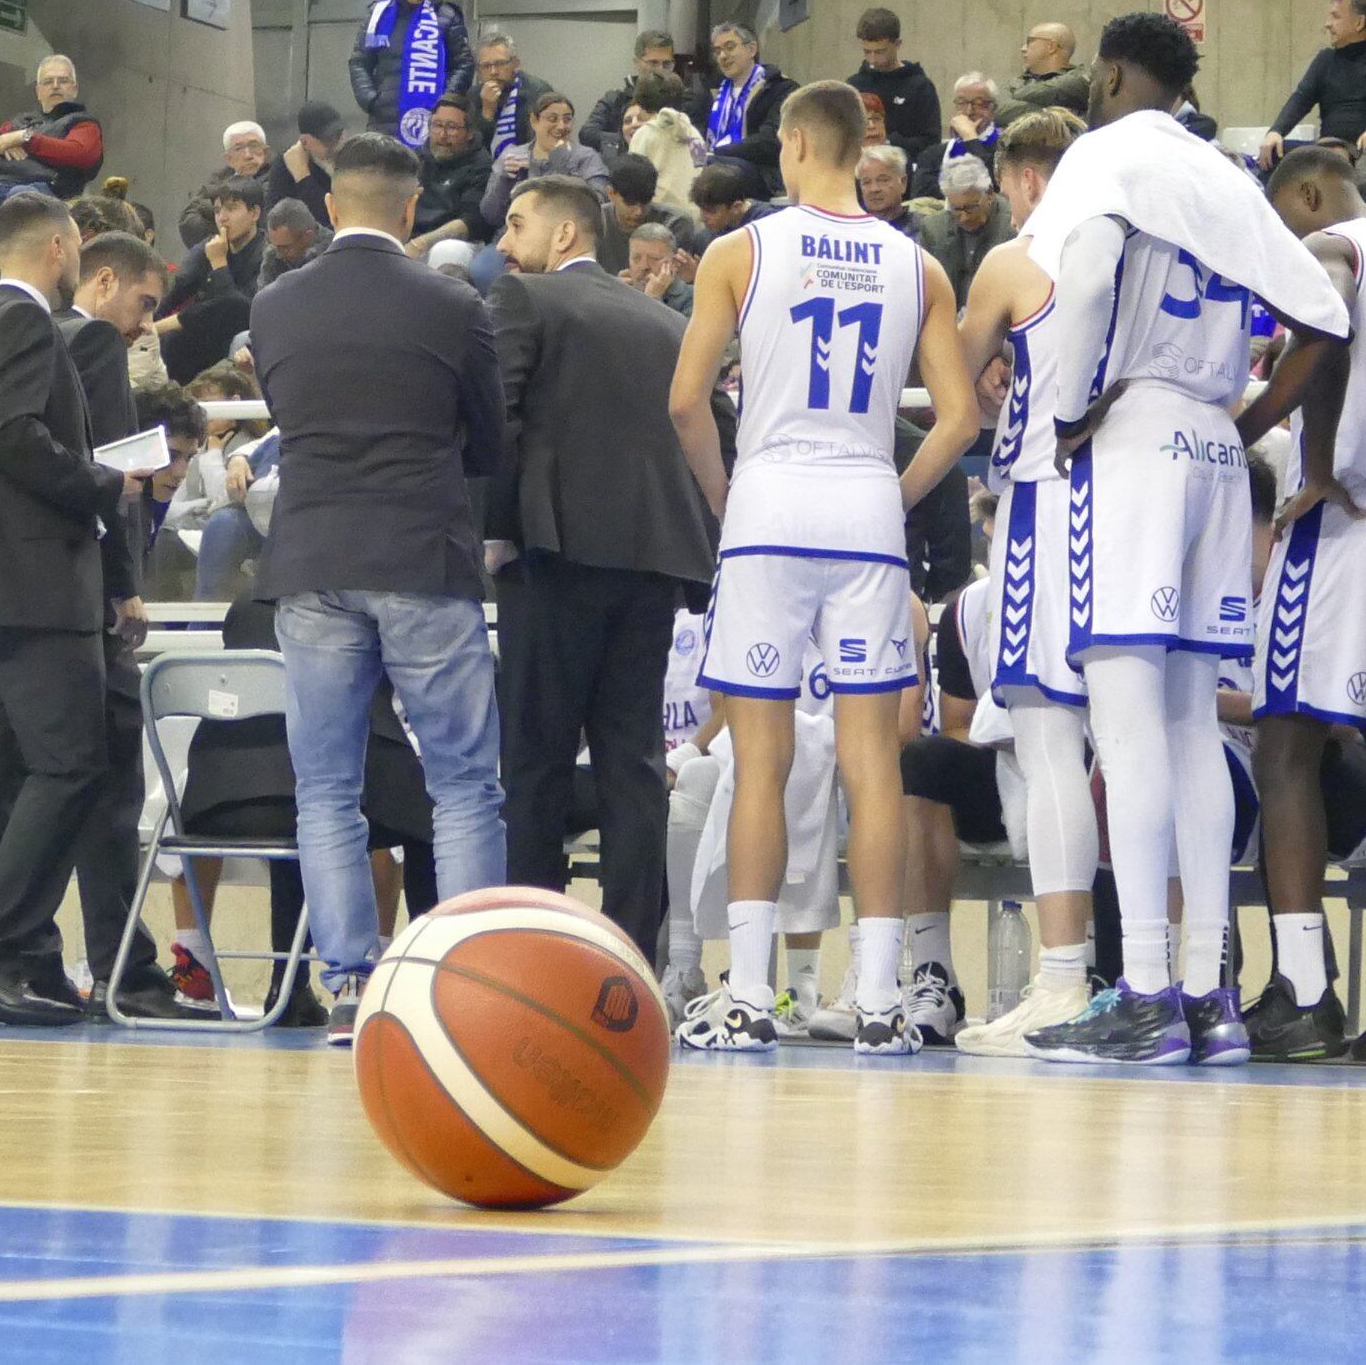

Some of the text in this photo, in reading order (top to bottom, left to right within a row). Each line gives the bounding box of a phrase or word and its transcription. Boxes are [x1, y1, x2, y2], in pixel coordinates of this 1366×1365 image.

[801, 235, 883, 265] BÁLINT
[816, 269, 878, 284] COMUNITAT
[821, 280, 885, 294] DE L'ESPORT
[790, 297, 883, 414] 11
[1206, 625, 1251, 635] SEAT
[833, 667, 877, 677] SEAT
